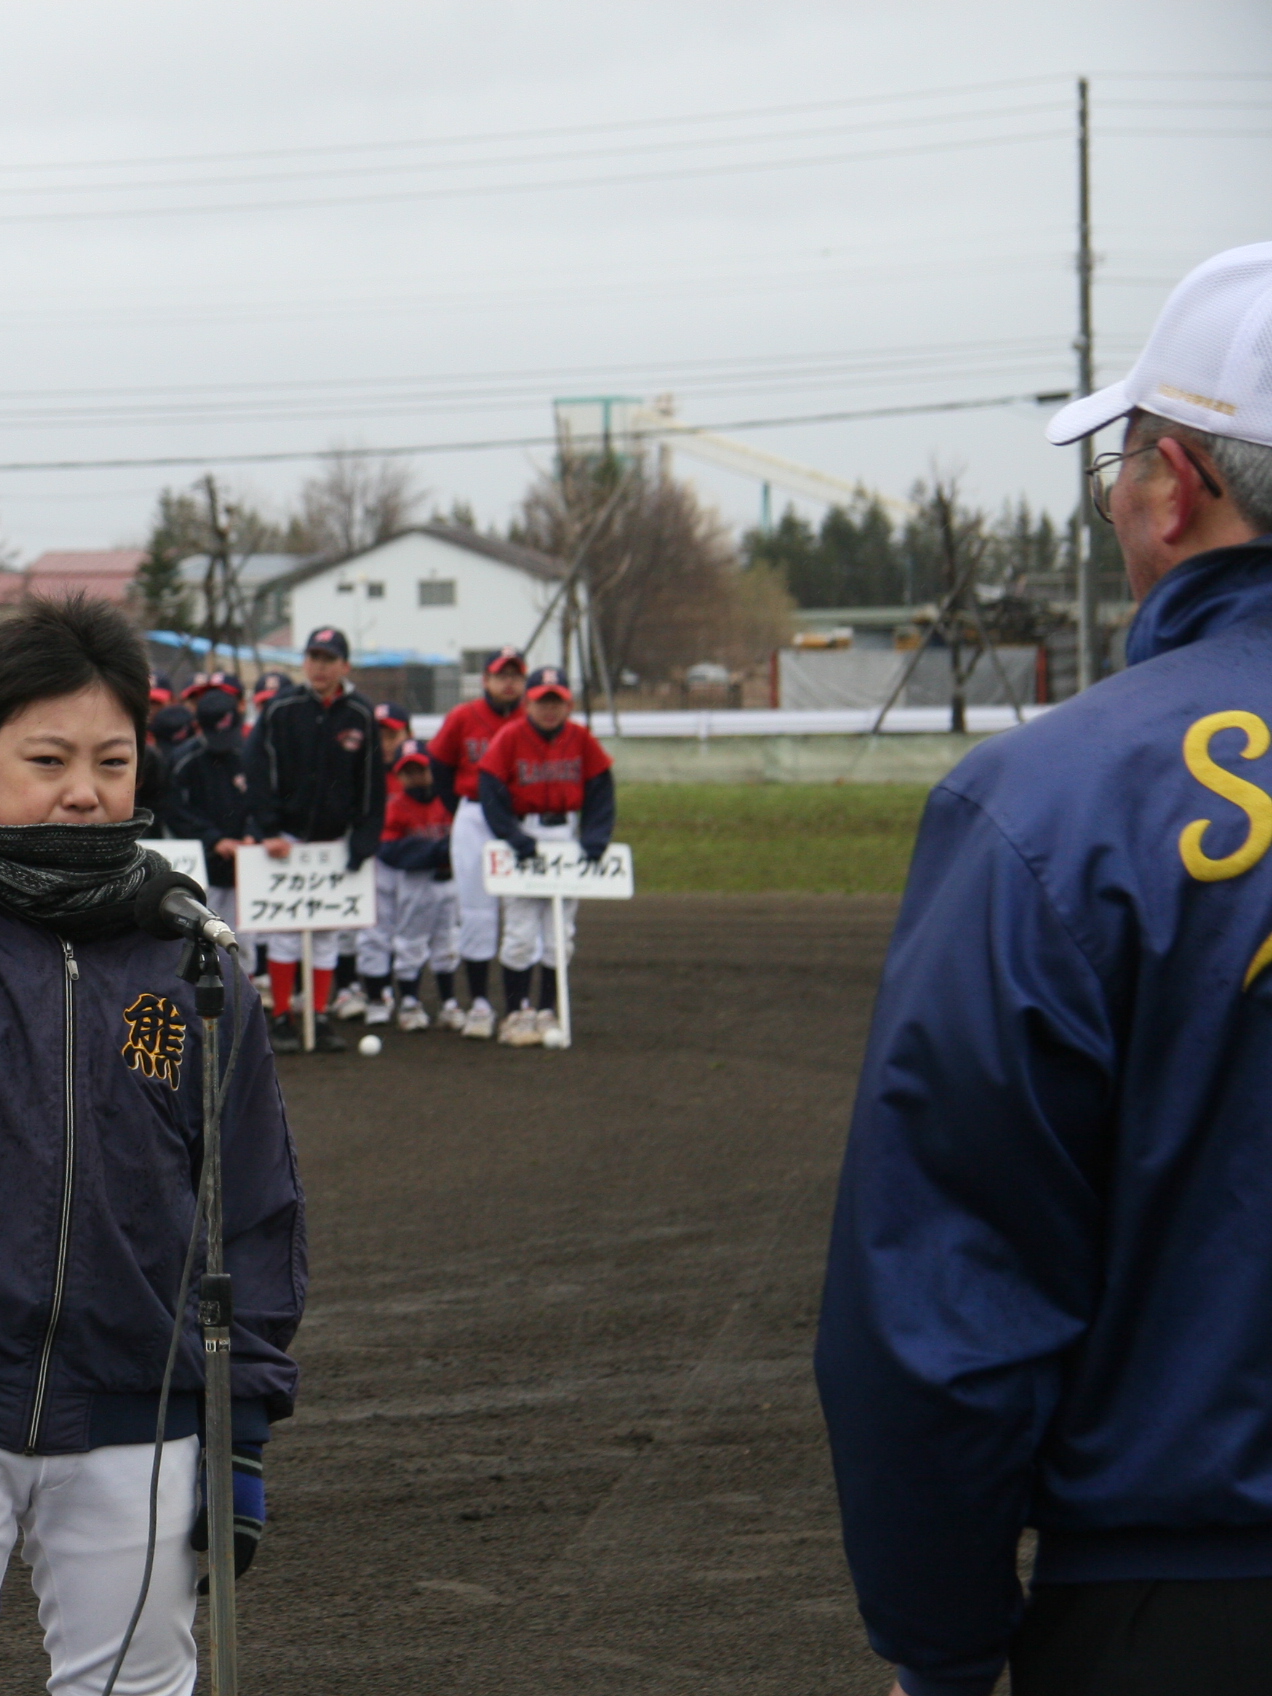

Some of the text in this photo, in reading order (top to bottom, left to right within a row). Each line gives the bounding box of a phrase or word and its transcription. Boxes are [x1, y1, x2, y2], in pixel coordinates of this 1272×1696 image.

[251, 895, 363, 921] ファイヤーズ
[122, 993, 186, 1091] 熊
